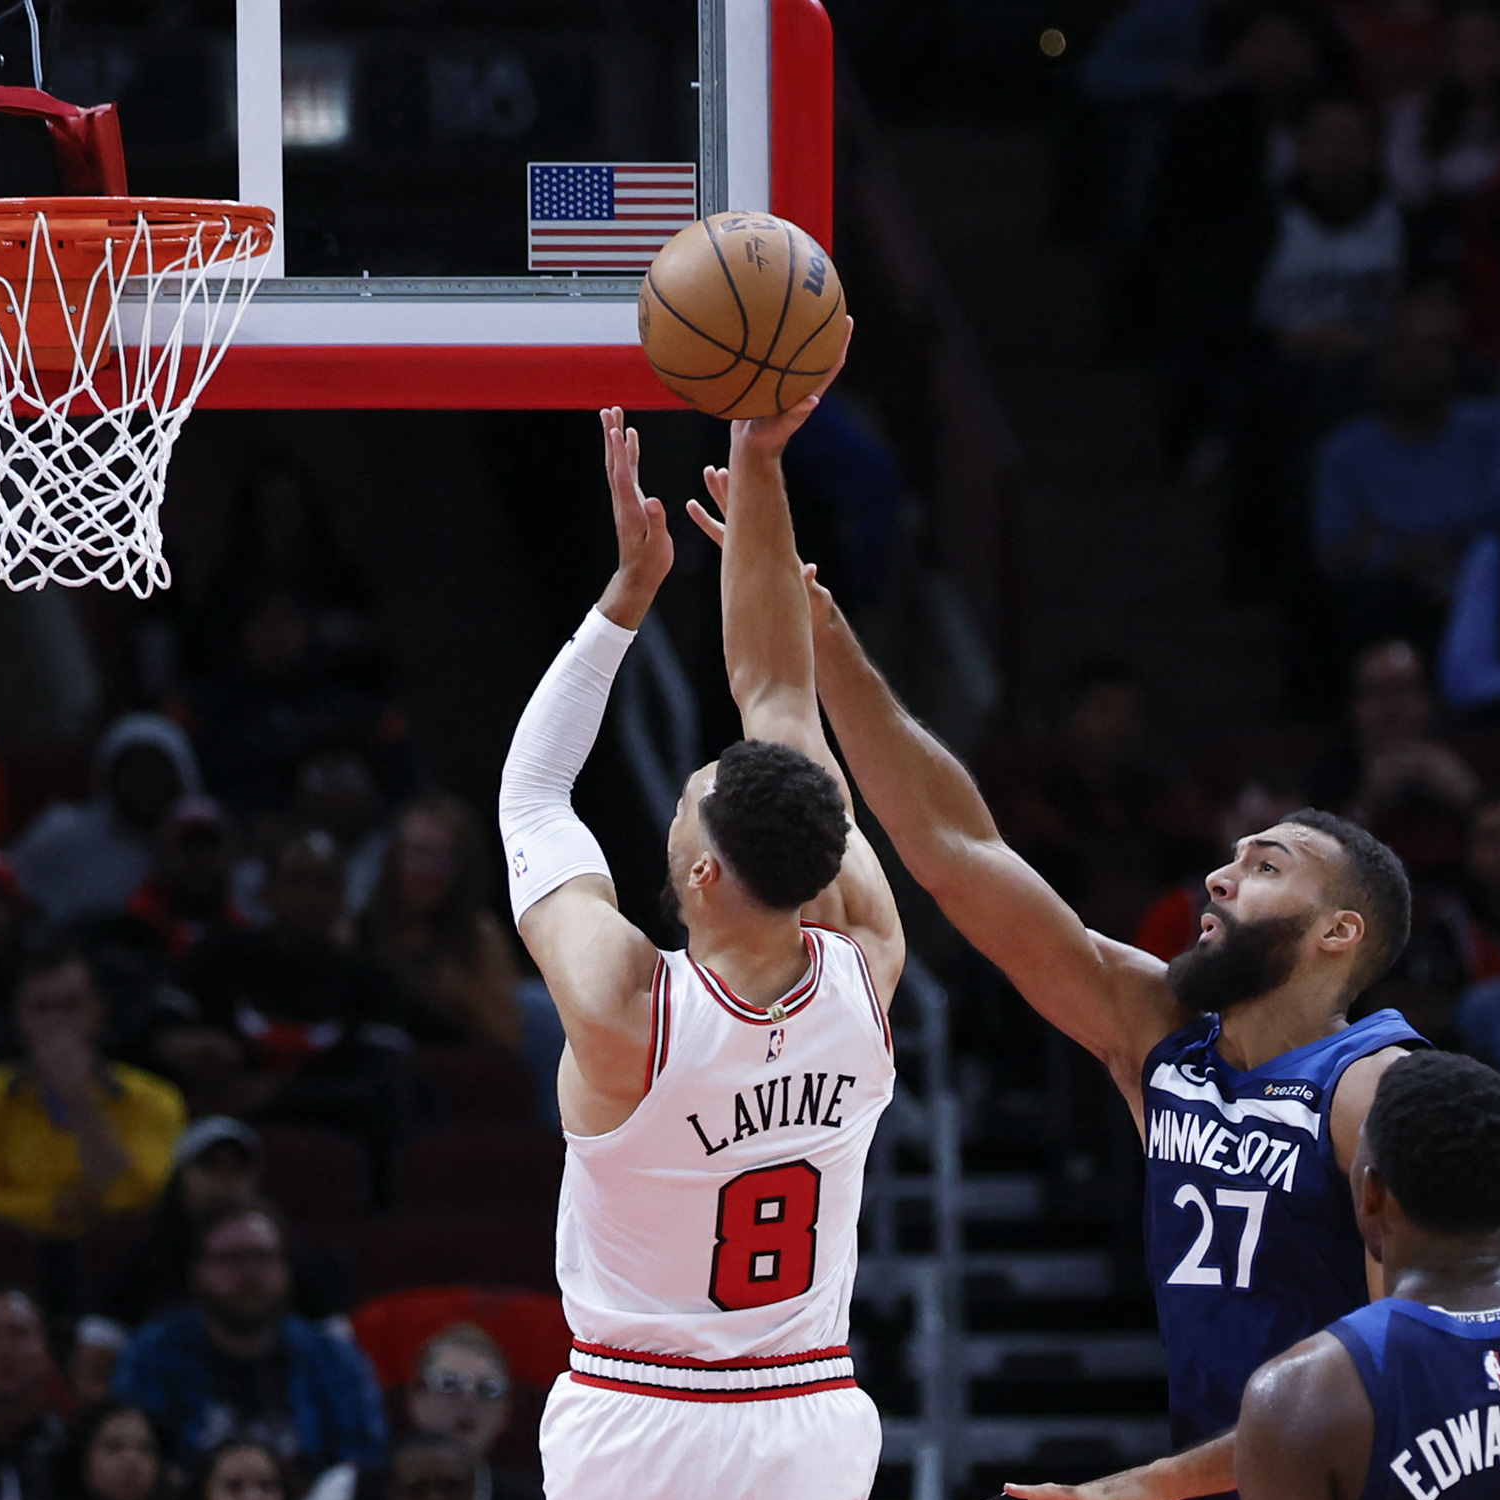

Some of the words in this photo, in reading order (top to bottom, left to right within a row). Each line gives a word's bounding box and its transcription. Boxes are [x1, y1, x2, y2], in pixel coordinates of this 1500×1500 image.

[686, 1073, 857, 1156] LAVINE
[1272, 1084, 1314, 1101] sezzle
[1147, 1108, 1302, 1193] MINNESOTA
[708, 1158, 823, 1313] 8
[1165, 1183, 1269, 1290] 27
